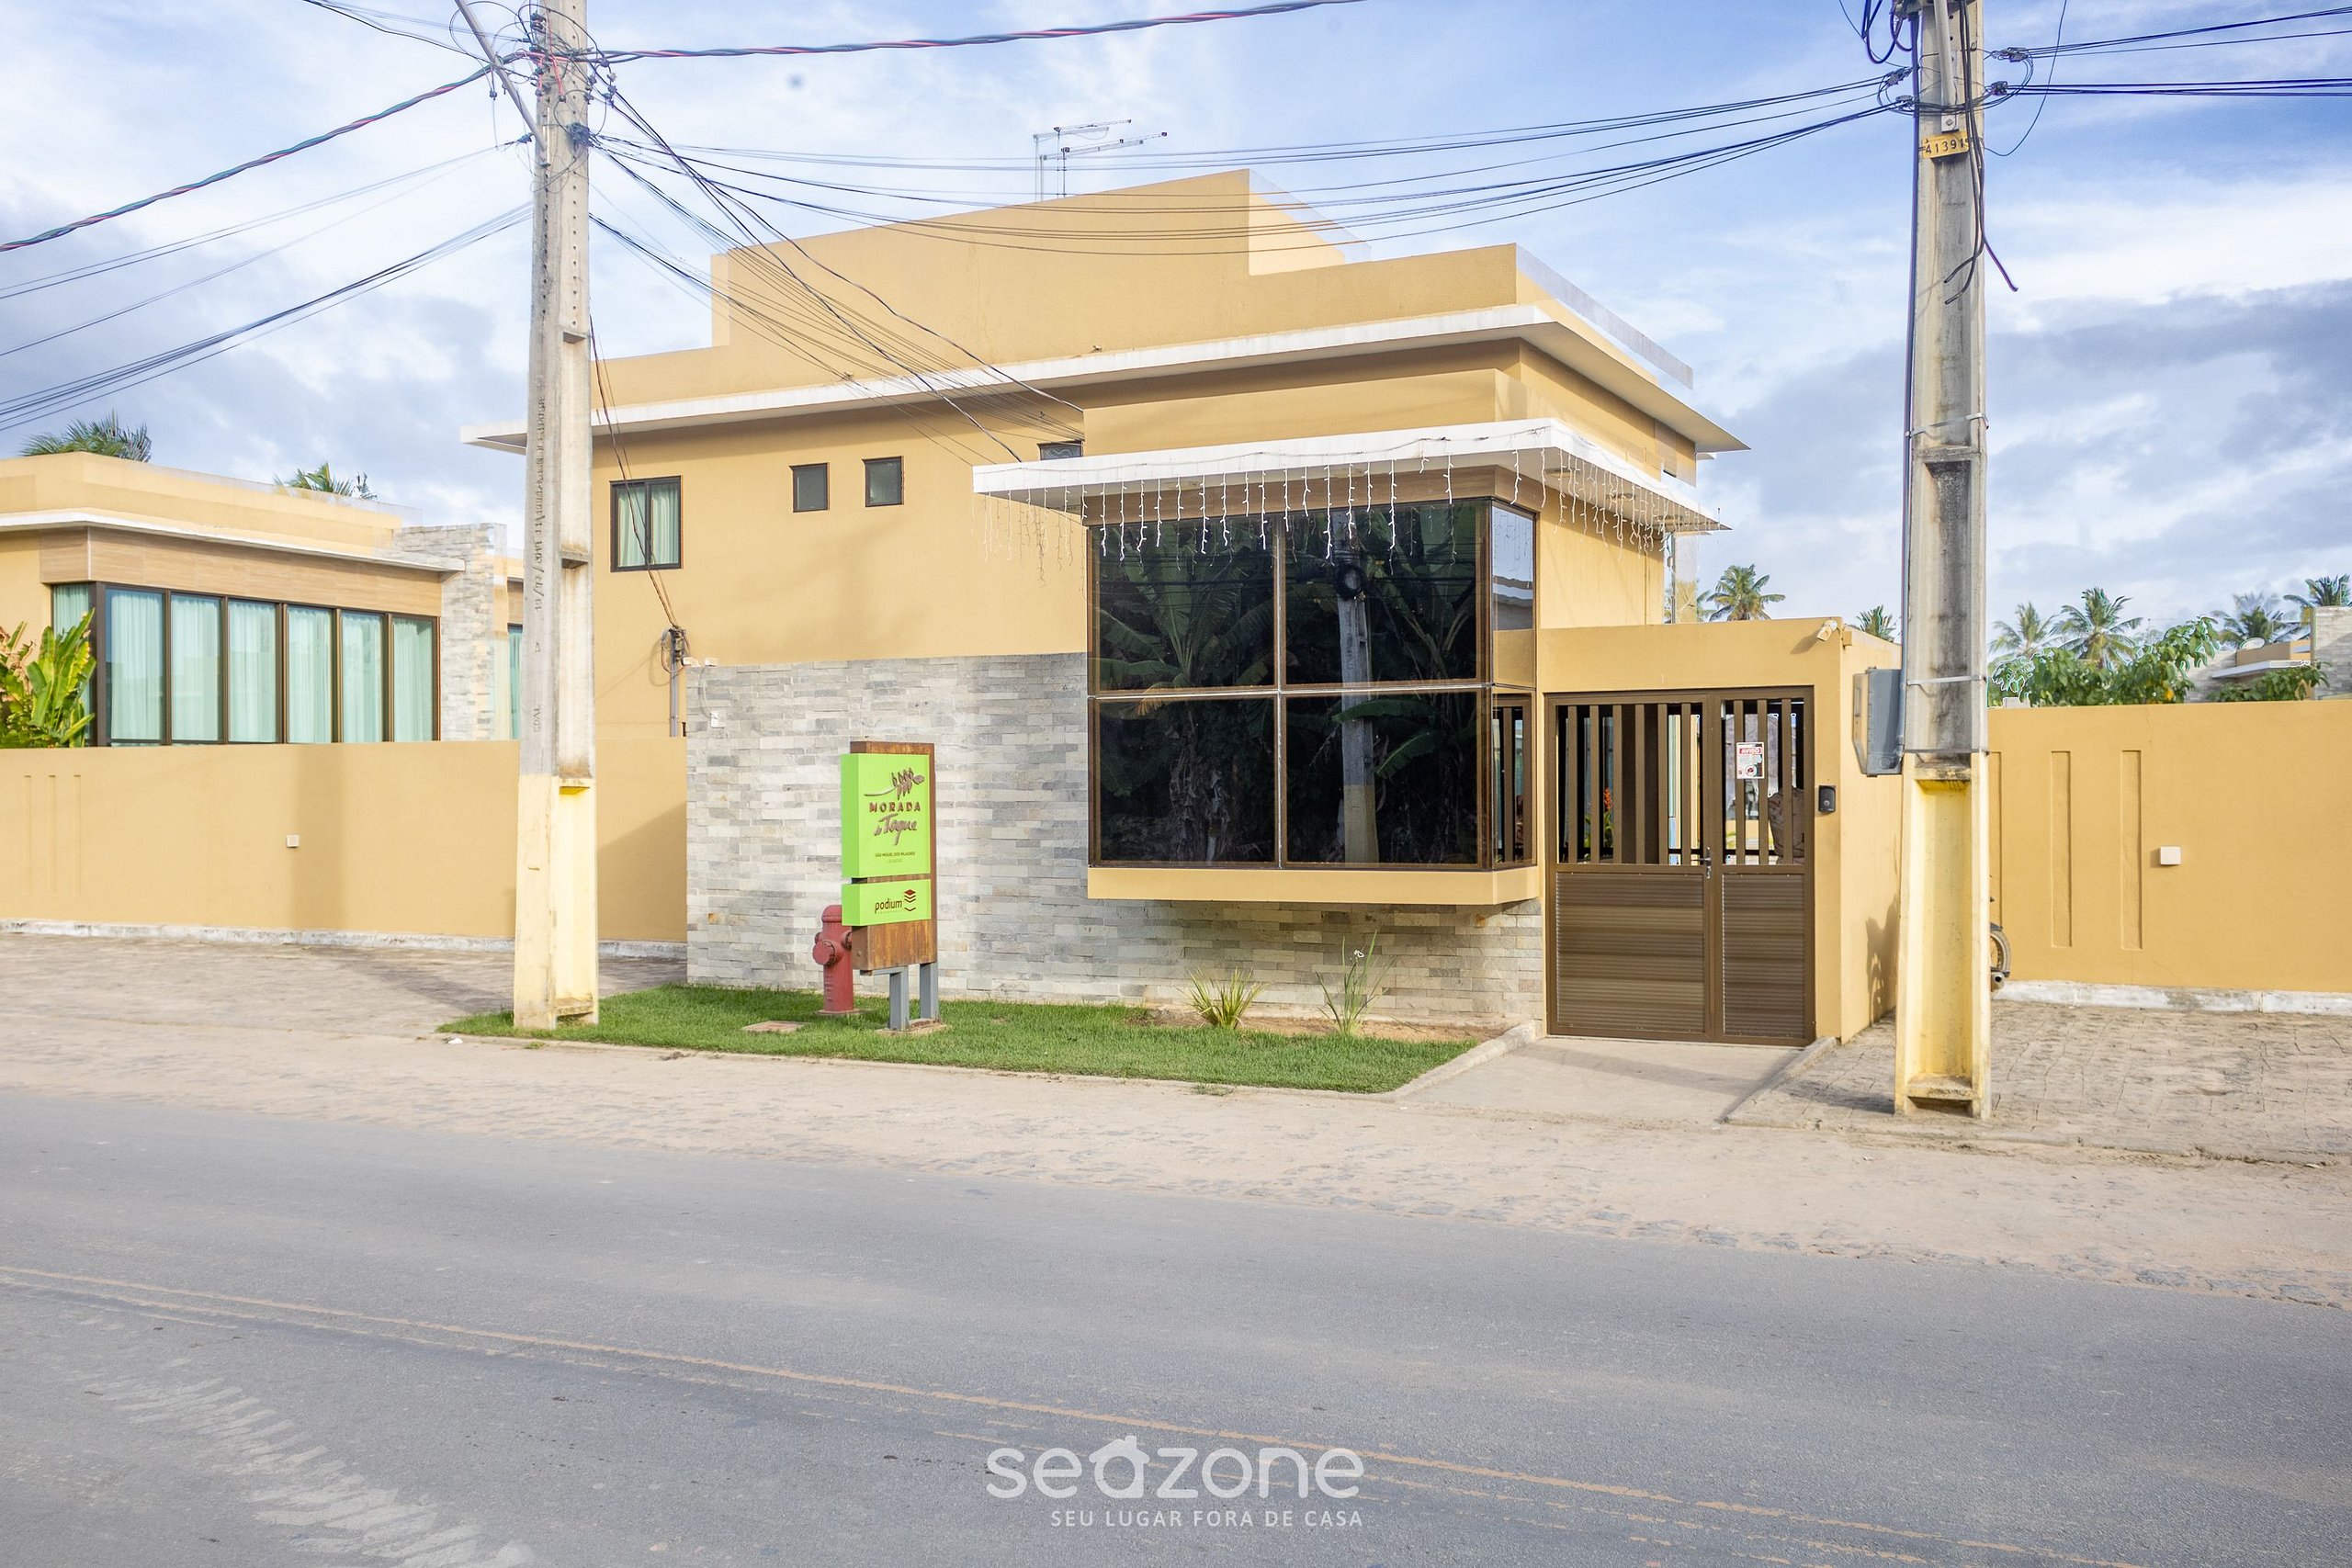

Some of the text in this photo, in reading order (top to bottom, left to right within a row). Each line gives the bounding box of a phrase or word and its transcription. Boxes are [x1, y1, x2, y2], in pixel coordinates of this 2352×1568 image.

[869, 801, 921, 813] MORADA
[878, 813, 918, 846] Toque
[875, 897, 903, 914] podium
